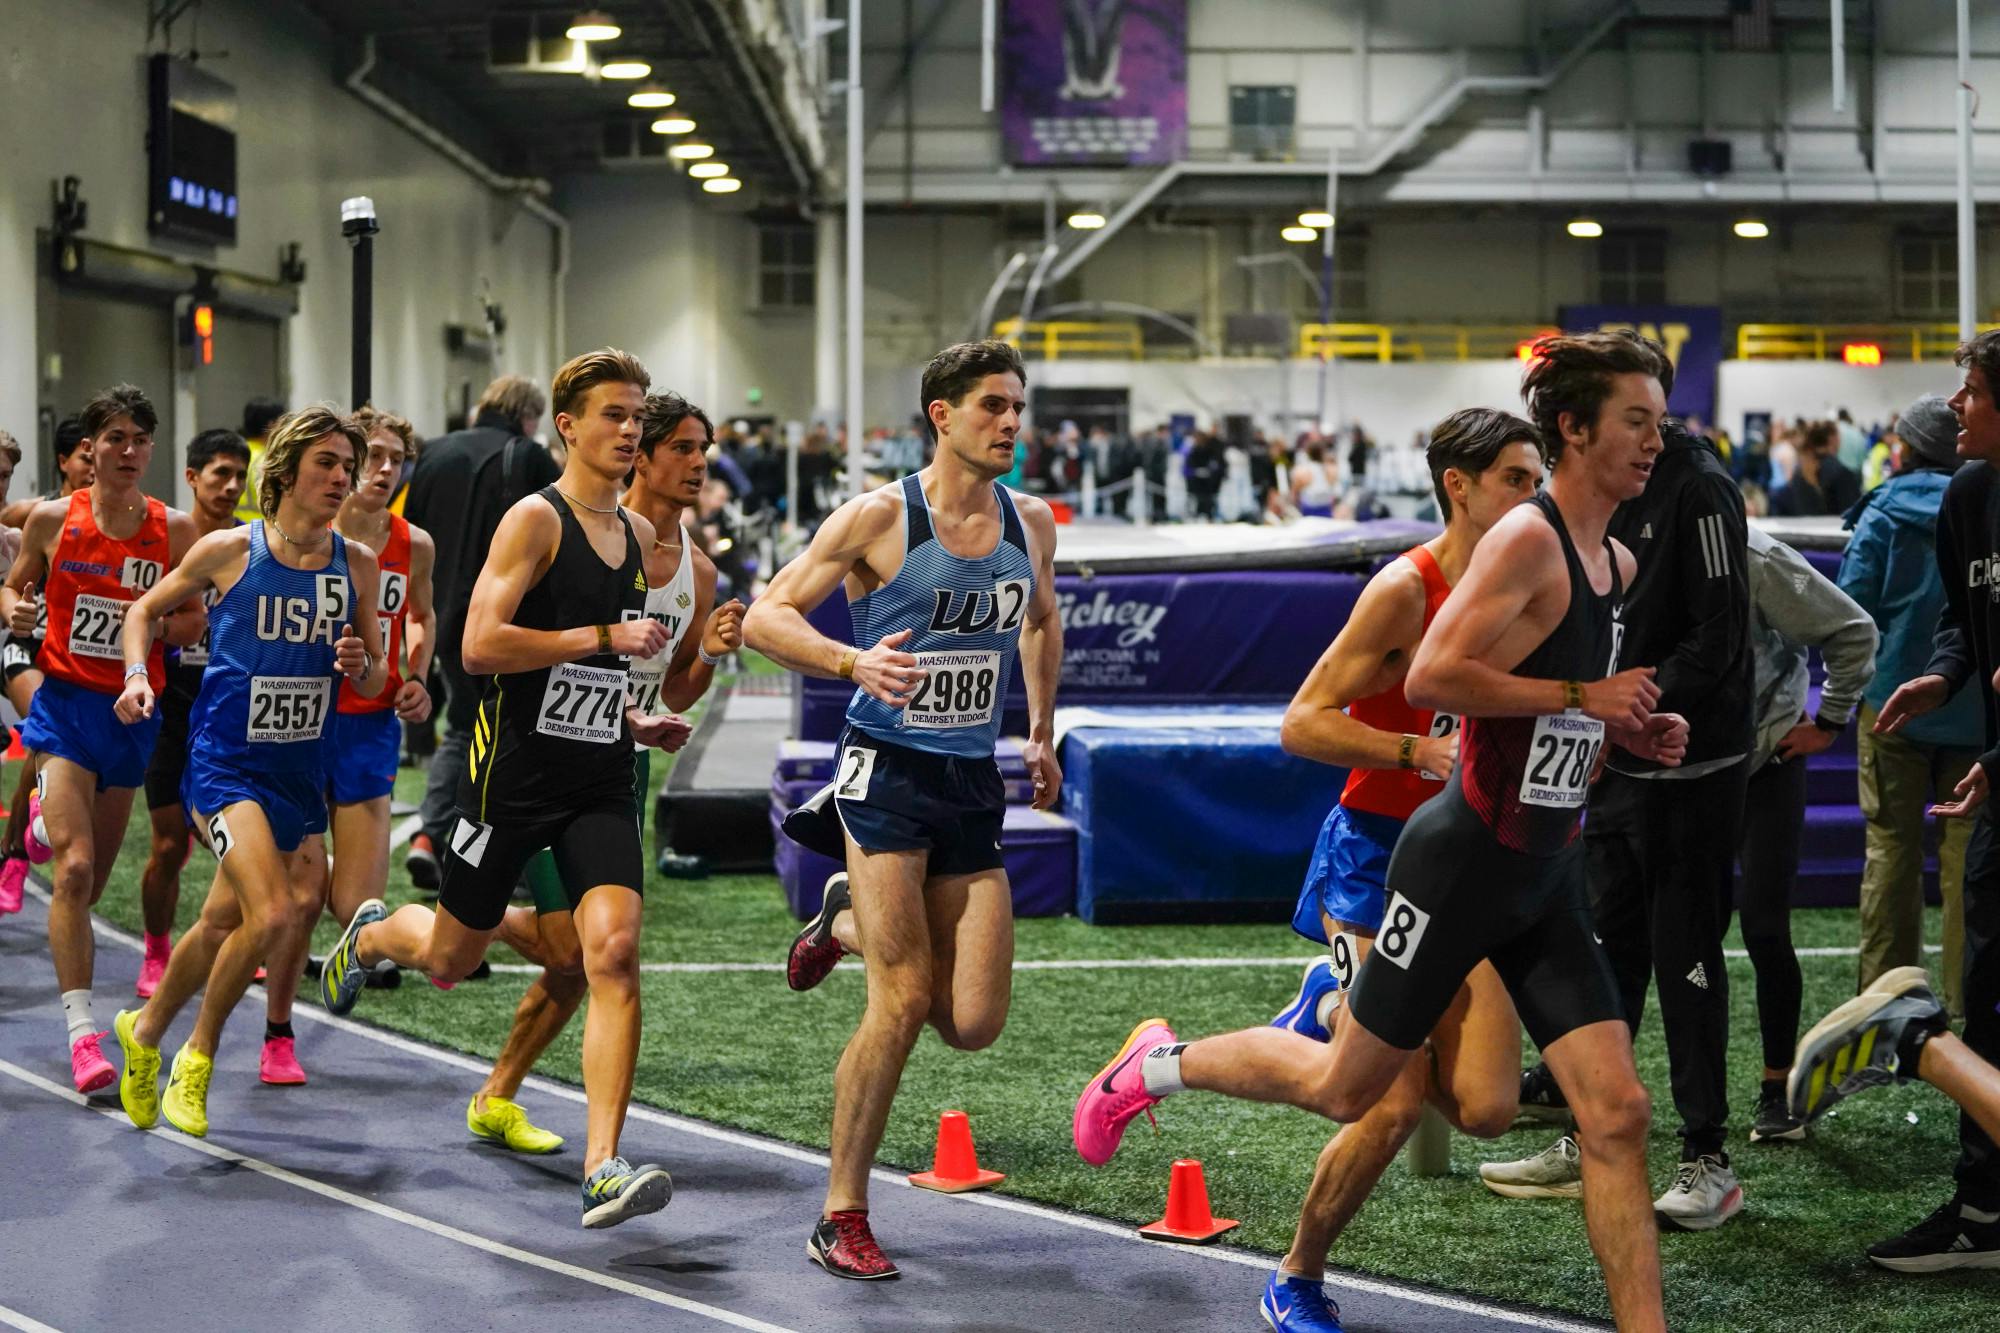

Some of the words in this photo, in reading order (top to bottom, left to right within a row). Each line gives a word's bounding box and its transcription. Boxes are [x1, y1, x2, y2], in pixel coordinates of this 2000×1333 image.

[60, 560, 112, 577] BOISE
[132, 560, 158, 590] 10
[325, 578, 344, 618] 5
[383, 575, 401, 612] 6
[1002, 582, 1024, 630] 2
[256, 595, 333, 646] USA
[1055, 591, 1168, 648] ichey
[561, 667, 624, 684] WASHINGTON
[919, 654, 990, 666] WASHINGTON
[260, 680, 324, 690] WASHINGTON
[908, 668, 994, 713] 2988
[252, 693, 323, 730] 2551
[544, 680, 622, 728] 2774
[912, 714, 956, 724] DEMPSEY
[254, 731, 291, 740] DEMPSEY
[545, 721, 586, 737] DEMPSEY
[586, 729, 615, 739] INDOOR
[1433, 715, 1460, 738] 2
[838, 749, 865, 796] 2
[1529, 788, 1568, 801] DEMPSEY
[209, 816, 228, 858] 5
[457, 821, 484, 856] 7
[1382, 903, 1417, 959] 8
[1334, 935, 1353, 989] 9
